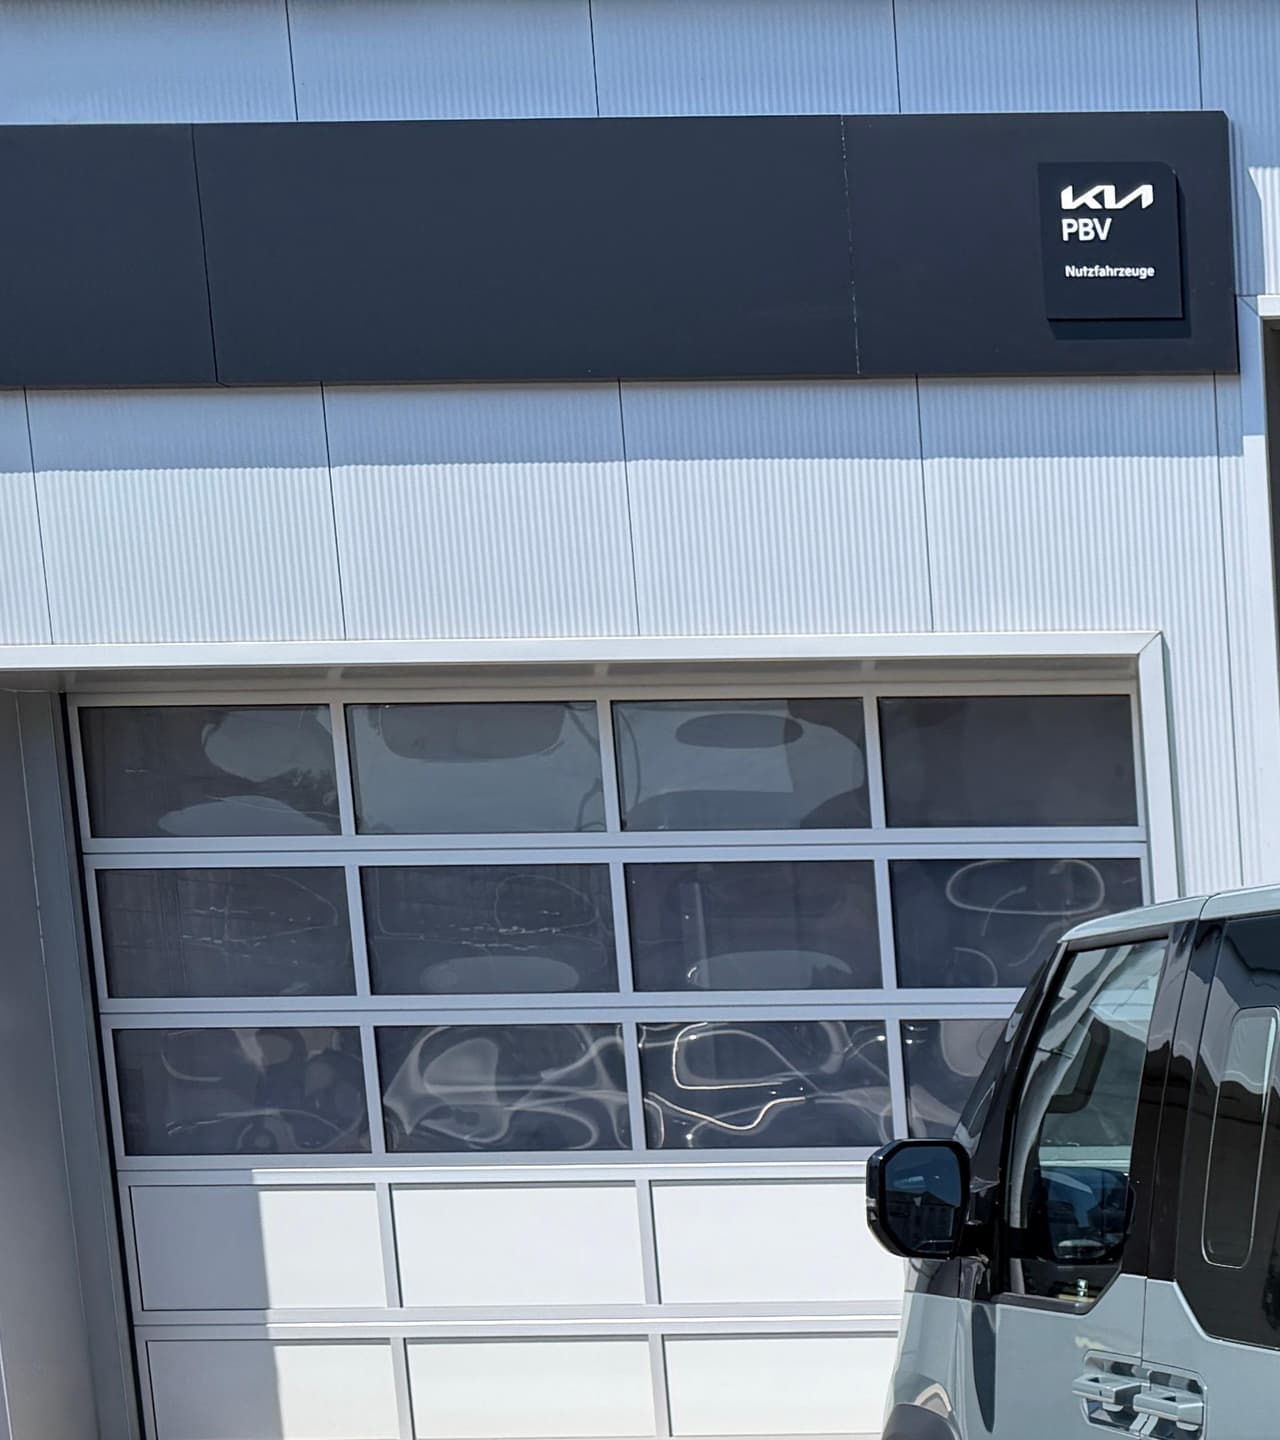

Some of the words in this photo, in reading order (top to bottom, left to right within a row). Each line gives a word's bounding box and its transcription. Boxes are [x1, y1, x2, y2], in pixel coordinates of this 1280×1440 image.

[1060, 184, 1154, 210] KIA
[1061, 218, 1112, 241] PBV
[1065, 265, 1155, 279] Nutzfahrzeuge
